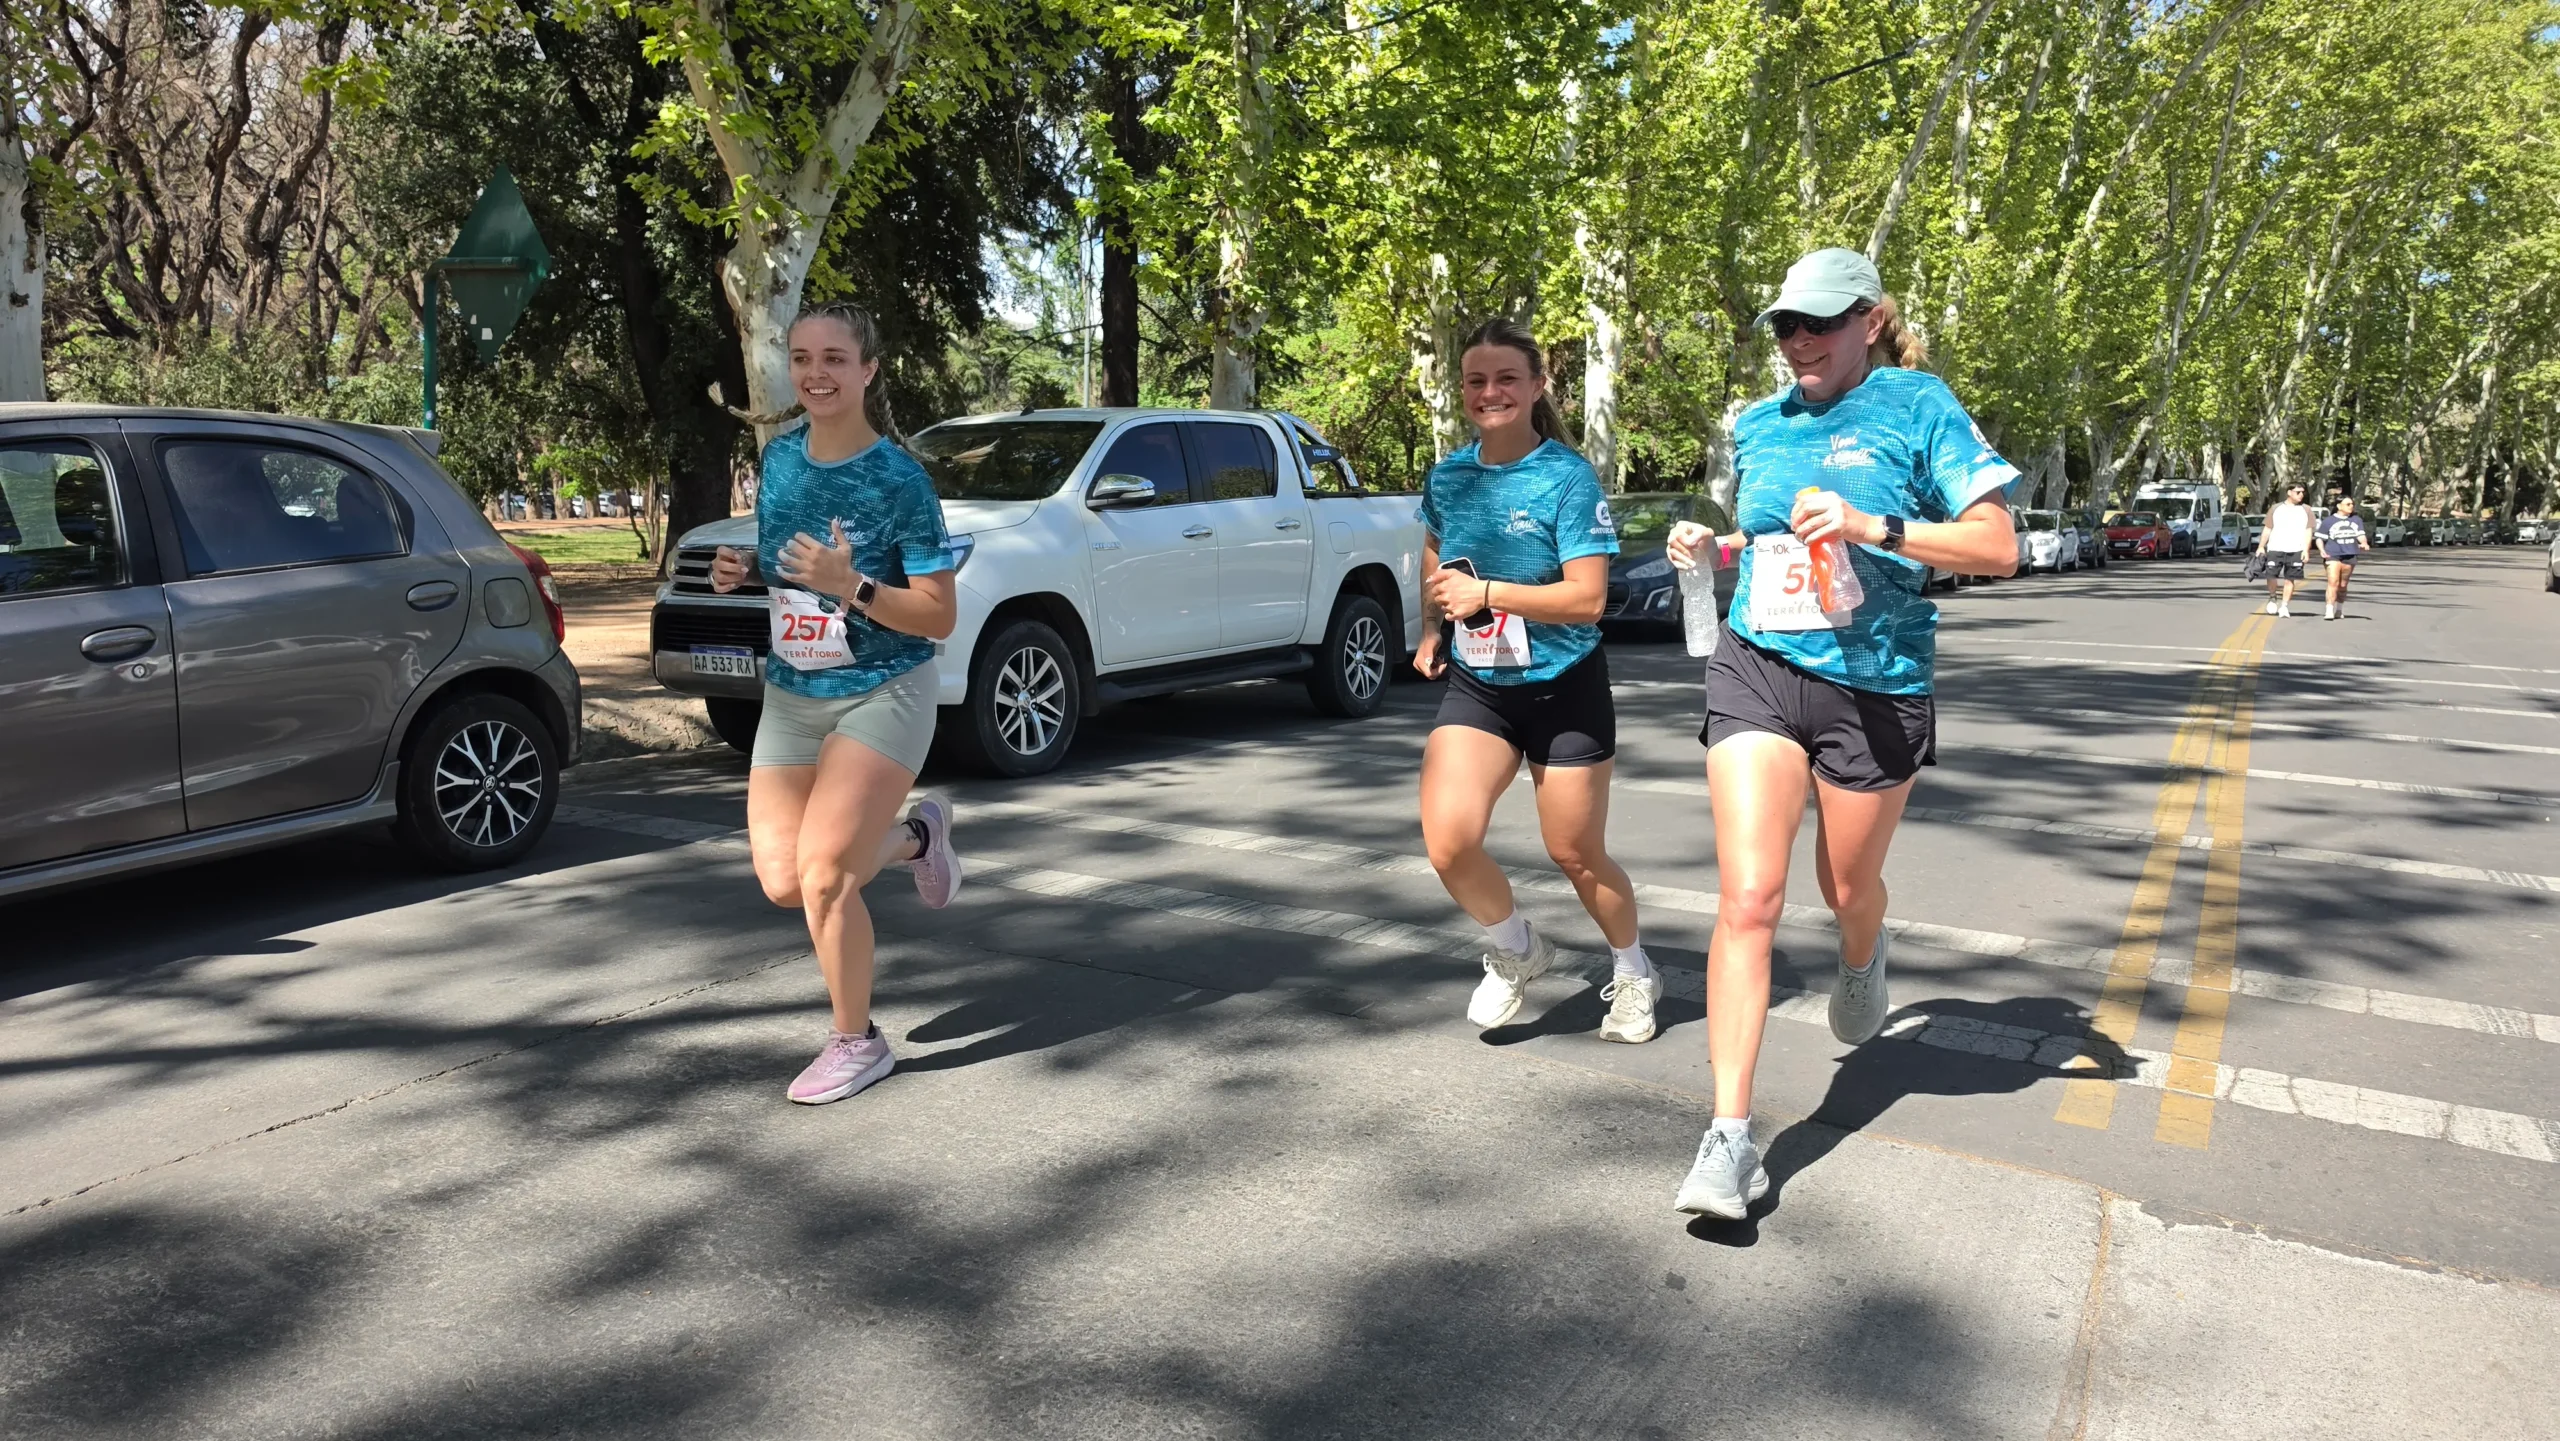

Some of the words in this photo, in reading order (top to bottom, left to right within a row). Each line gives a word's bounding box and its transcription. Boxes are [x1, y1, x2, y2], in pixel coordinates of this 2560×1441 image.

[1590, 527, 1615, 535] GATORA
[1772, 544, 1790, 555] 10k
[1767, 601, 1819, 616] TERRITO
[781, 613, 831, 641] 257
[783, 646, 842, 658] TERRITORIO
[1466, 643, 1520, 655] TERRITORIO
[694, 655, 708, 671] AA
[711, 656, 733, 672] 533
[736, 657, 752, 674] RX
